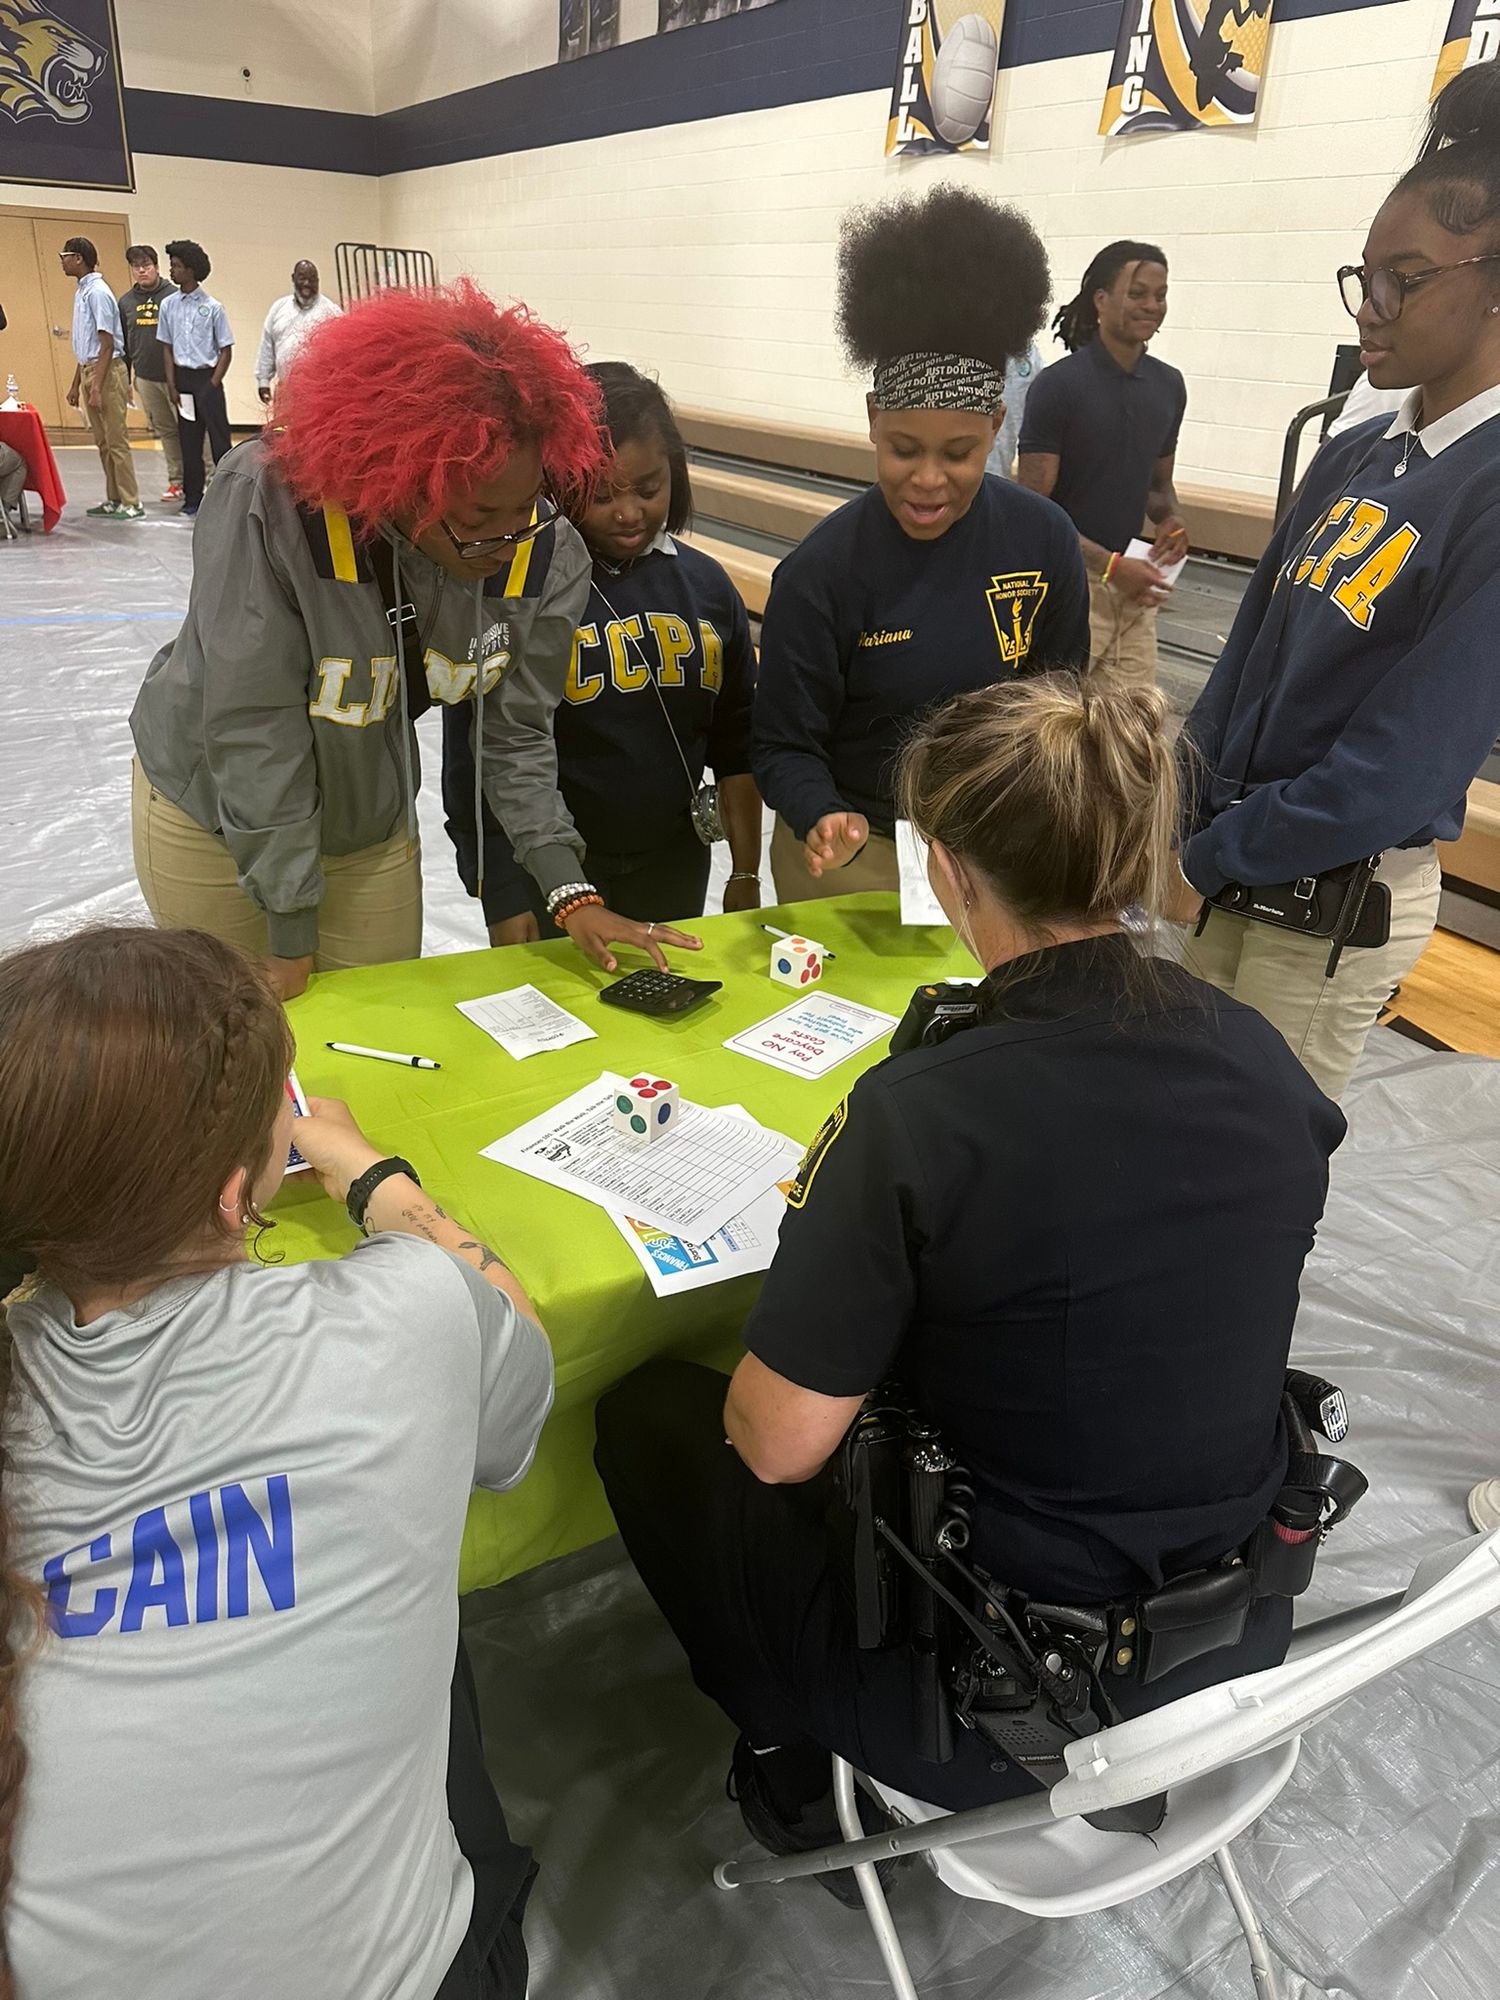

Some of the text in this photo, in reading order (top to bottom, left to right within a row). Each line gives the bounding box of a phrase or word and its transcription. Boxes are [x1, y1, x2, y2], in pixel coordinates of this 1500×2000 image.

[925, 366, 946, 376] JUST
[946, 365, 960, 375] DO
[913, 377, 927, 386] DO
[1002, 580, 1030, 590] NATIONAL
[995, 588, 1040, 600] HONOR SOCIETY
[772, 1032, 824, 1056] Daycare
[790, 1030, 825, 1046] Costs
[762, 1040, 812, 1062] Pay NO
[652, 1250, 690, 1271] FINANCES
[42, 1473, 296, 1639] CAIN
